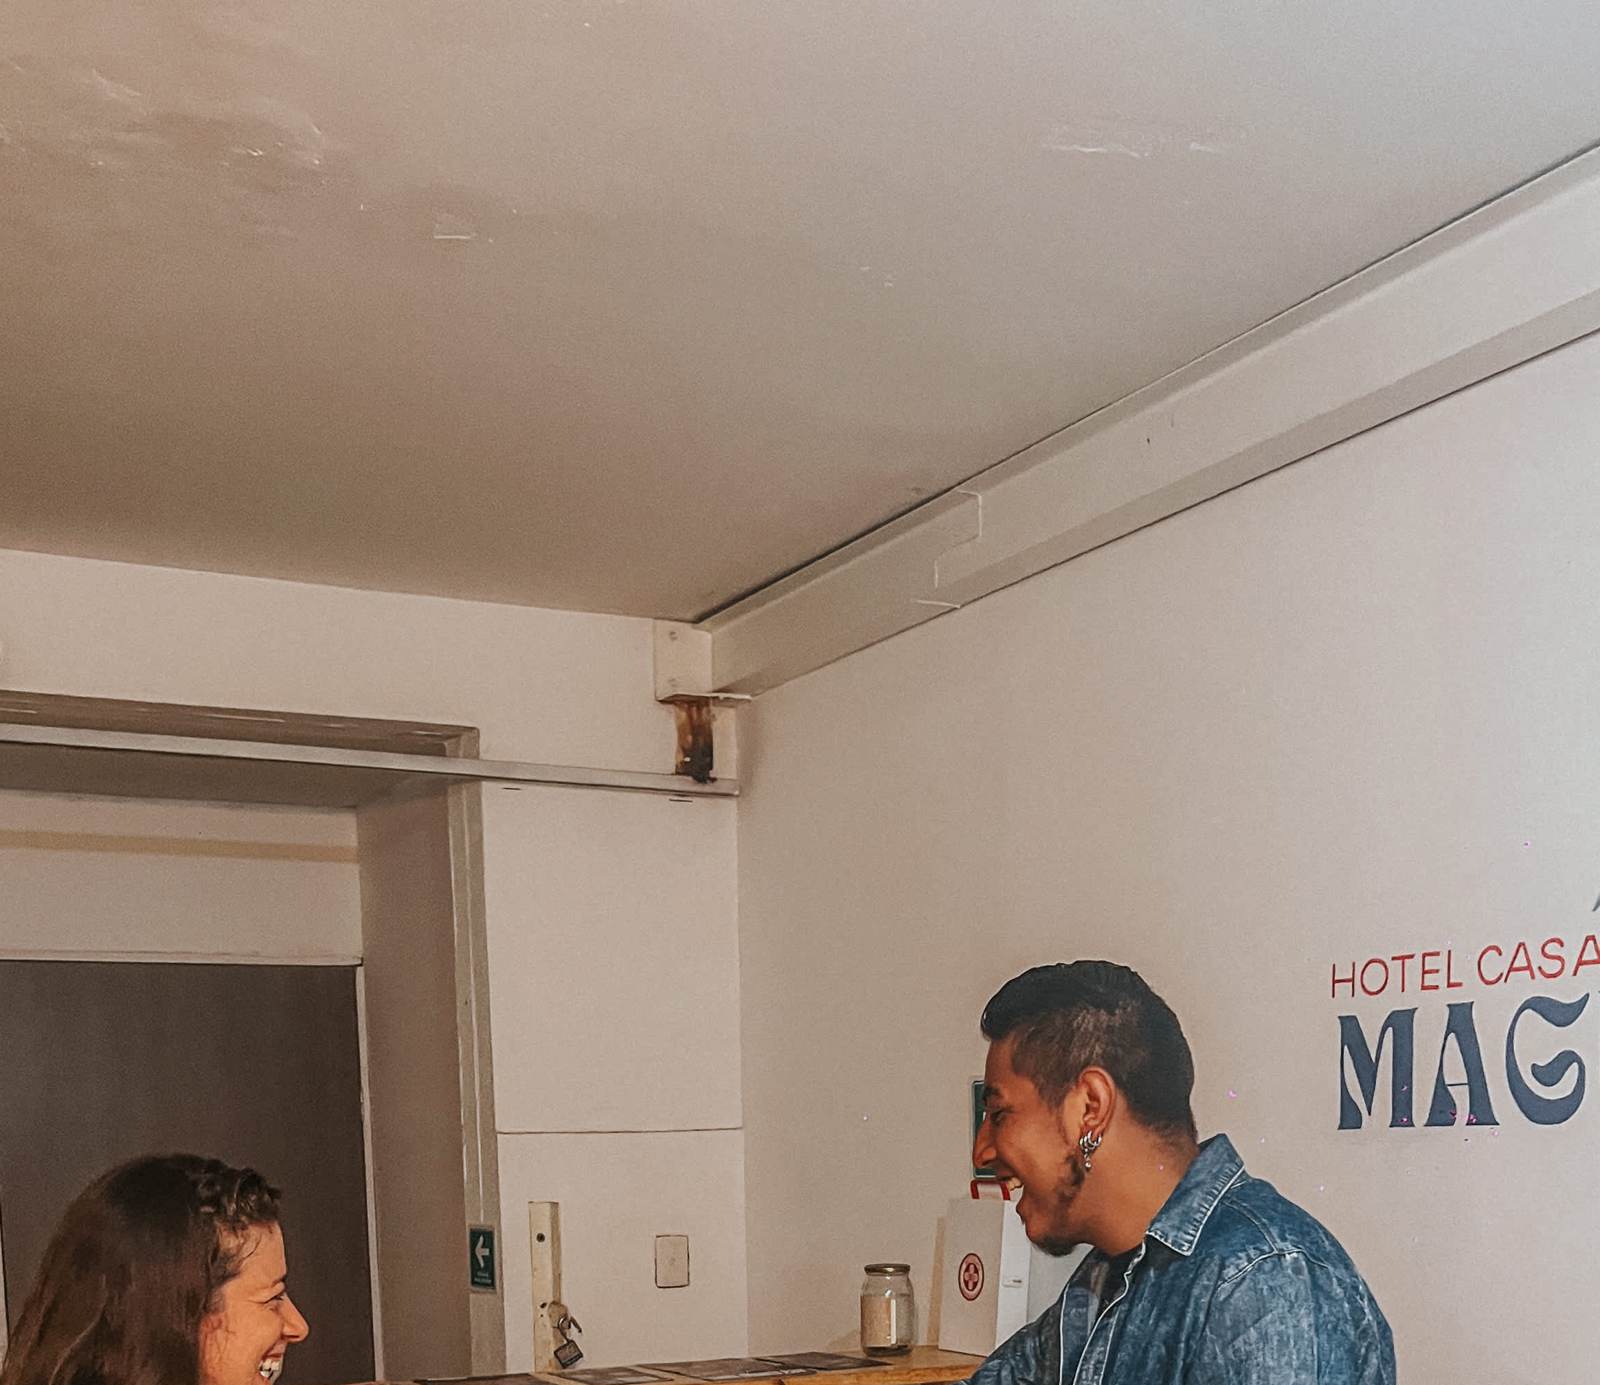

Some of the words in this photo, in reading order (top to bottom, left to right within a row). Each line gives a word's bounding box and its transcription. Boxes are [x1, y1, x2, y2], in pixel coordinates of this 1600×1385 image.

[1331, 949, 1463, 999] HOTEL
[1477, 934, 1600, 986] CASA
[1337, 991, 1600, 1130] MAG
